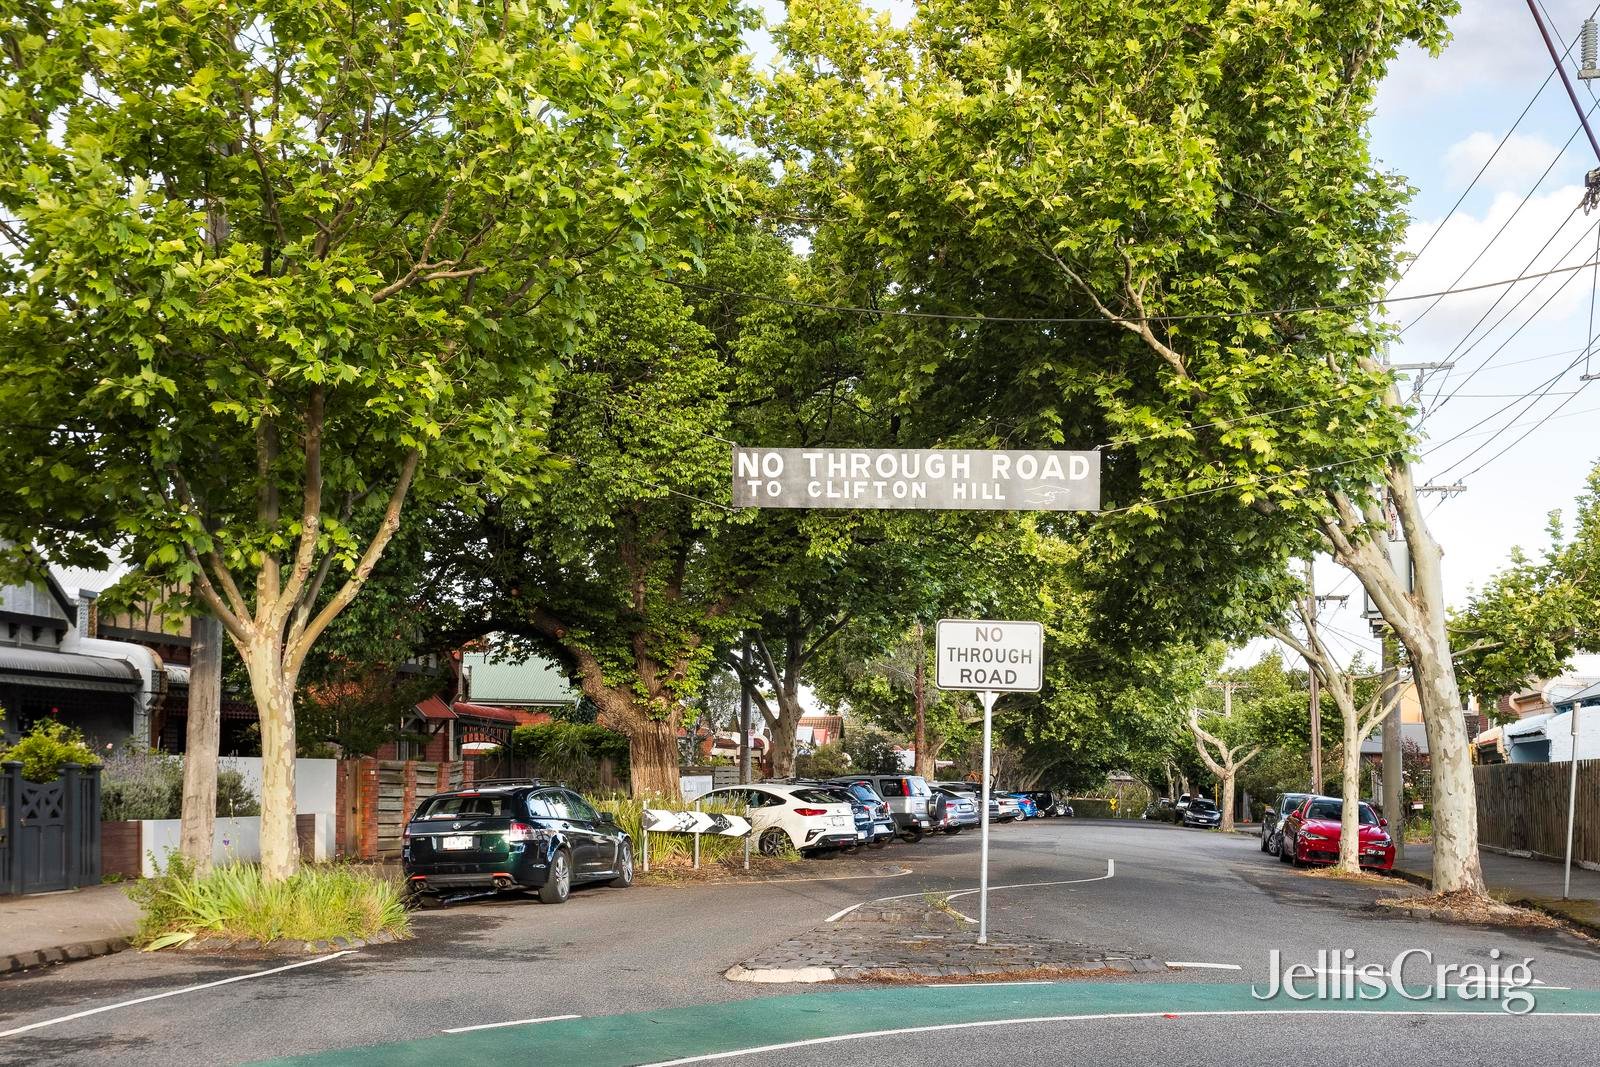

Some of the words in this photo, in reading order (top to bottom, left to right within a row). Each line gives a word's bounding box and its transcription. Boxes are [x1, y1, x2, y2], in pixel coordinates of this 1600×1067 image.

[737, 452, 784, 478] NO
[803, 452, 970, 480] THROUGH
[993, 454, 1090, 480] ROAD
[747, 480, 782, 497] TO
[808, 480, 927, 499] CLIFTON
[953, 483, 1006, 501] HILL
[976, 627, 1003, 642] NO
[947, 647, 1032, 664] THROUGH
[961, 668, 1018, 685] ROAD
